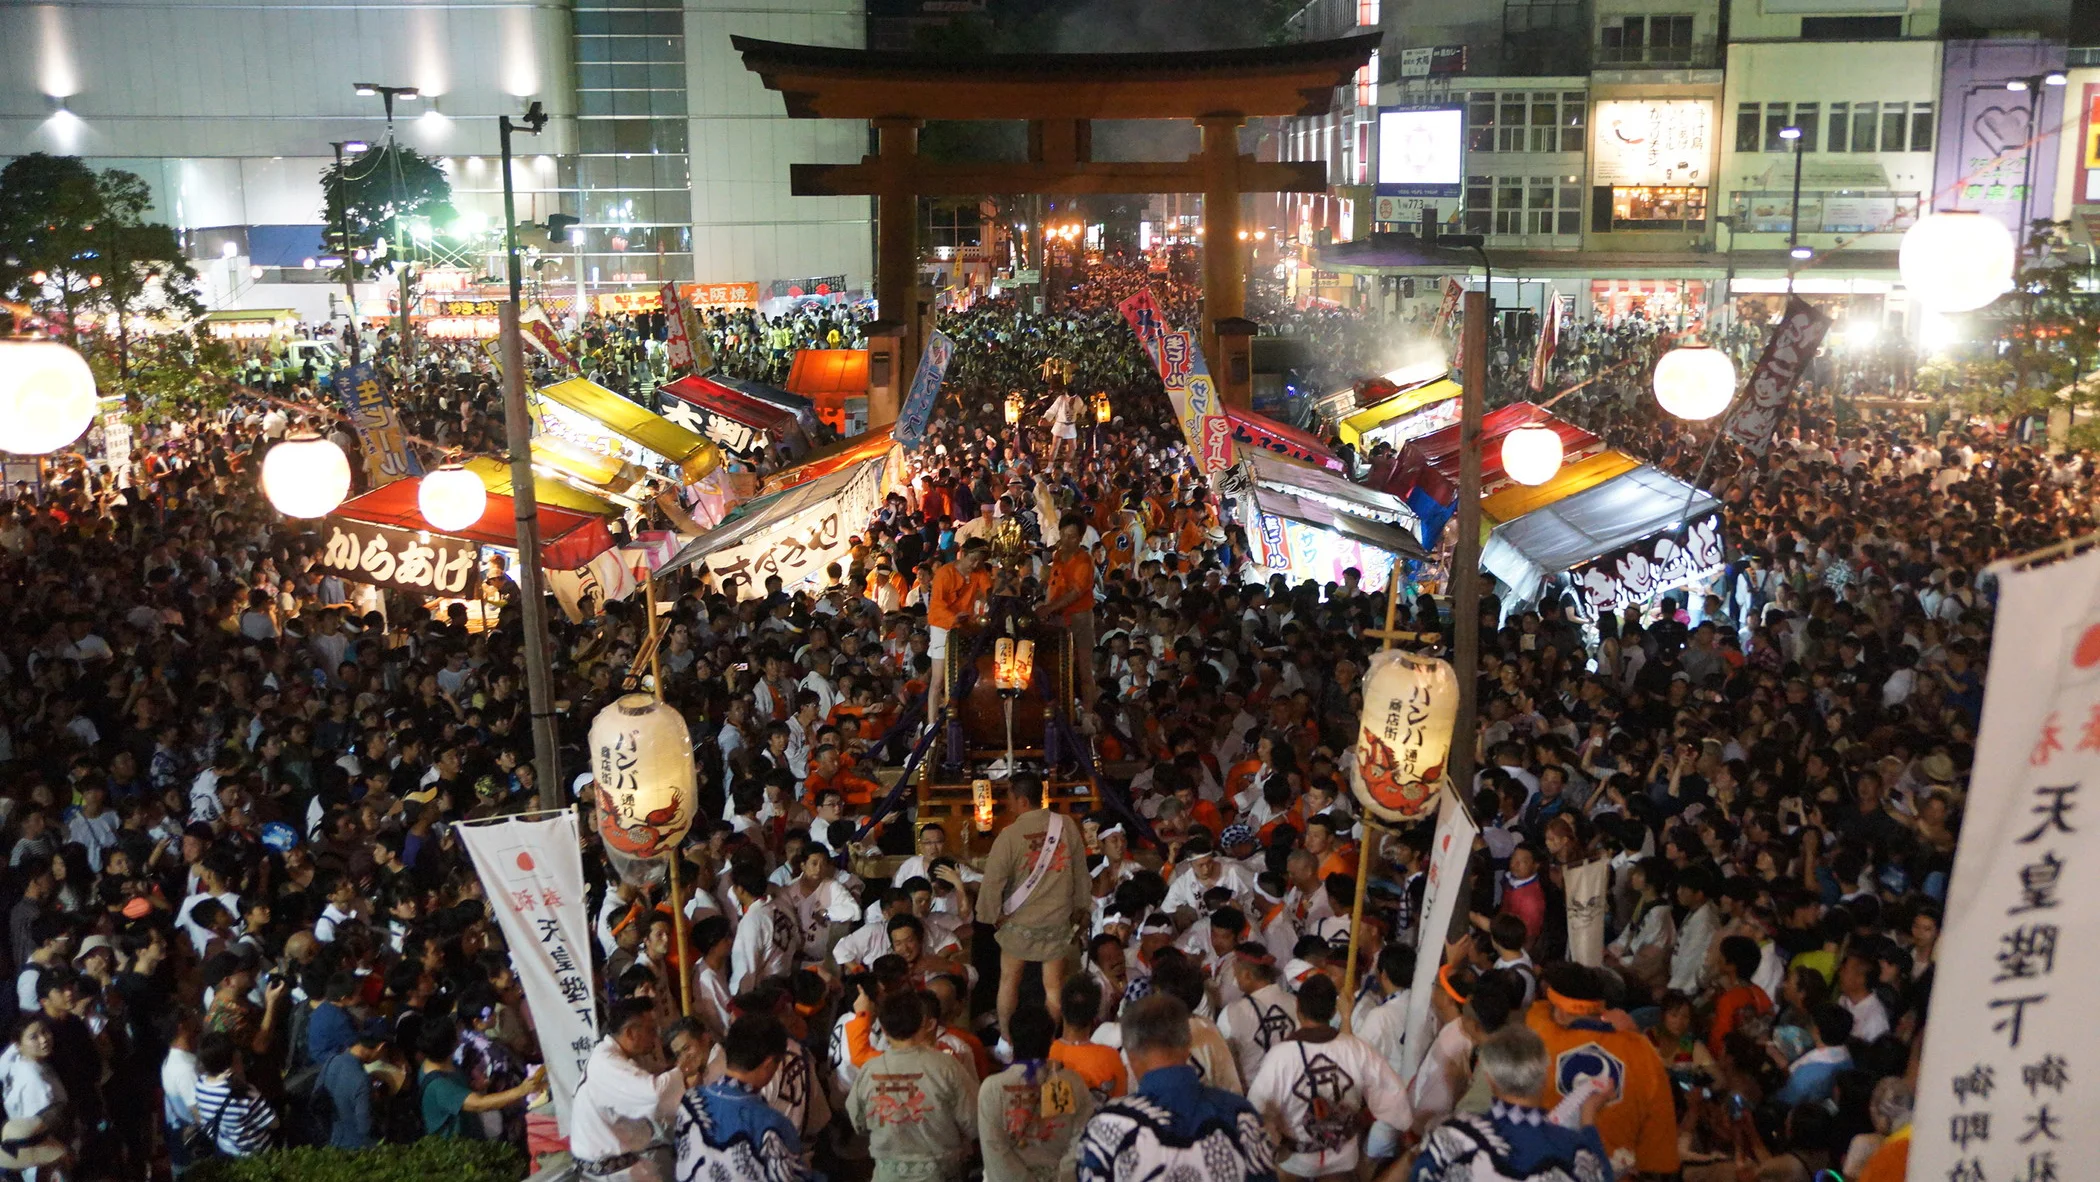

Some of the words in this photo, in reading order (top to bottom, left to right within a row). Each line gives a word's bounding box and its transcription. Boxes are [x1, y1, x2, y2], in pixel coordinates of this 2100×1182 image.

[691, 286, 749, 303] 大阪焼
[323, 526, 477, 593] からあげ
[713, 512, 838, 588] すずきや
[1384, 698, 1402, 742] 商店街
[1402, 685, 1433, 776] バンバ通り
[614, 728, 639, 819] バンバ通り
